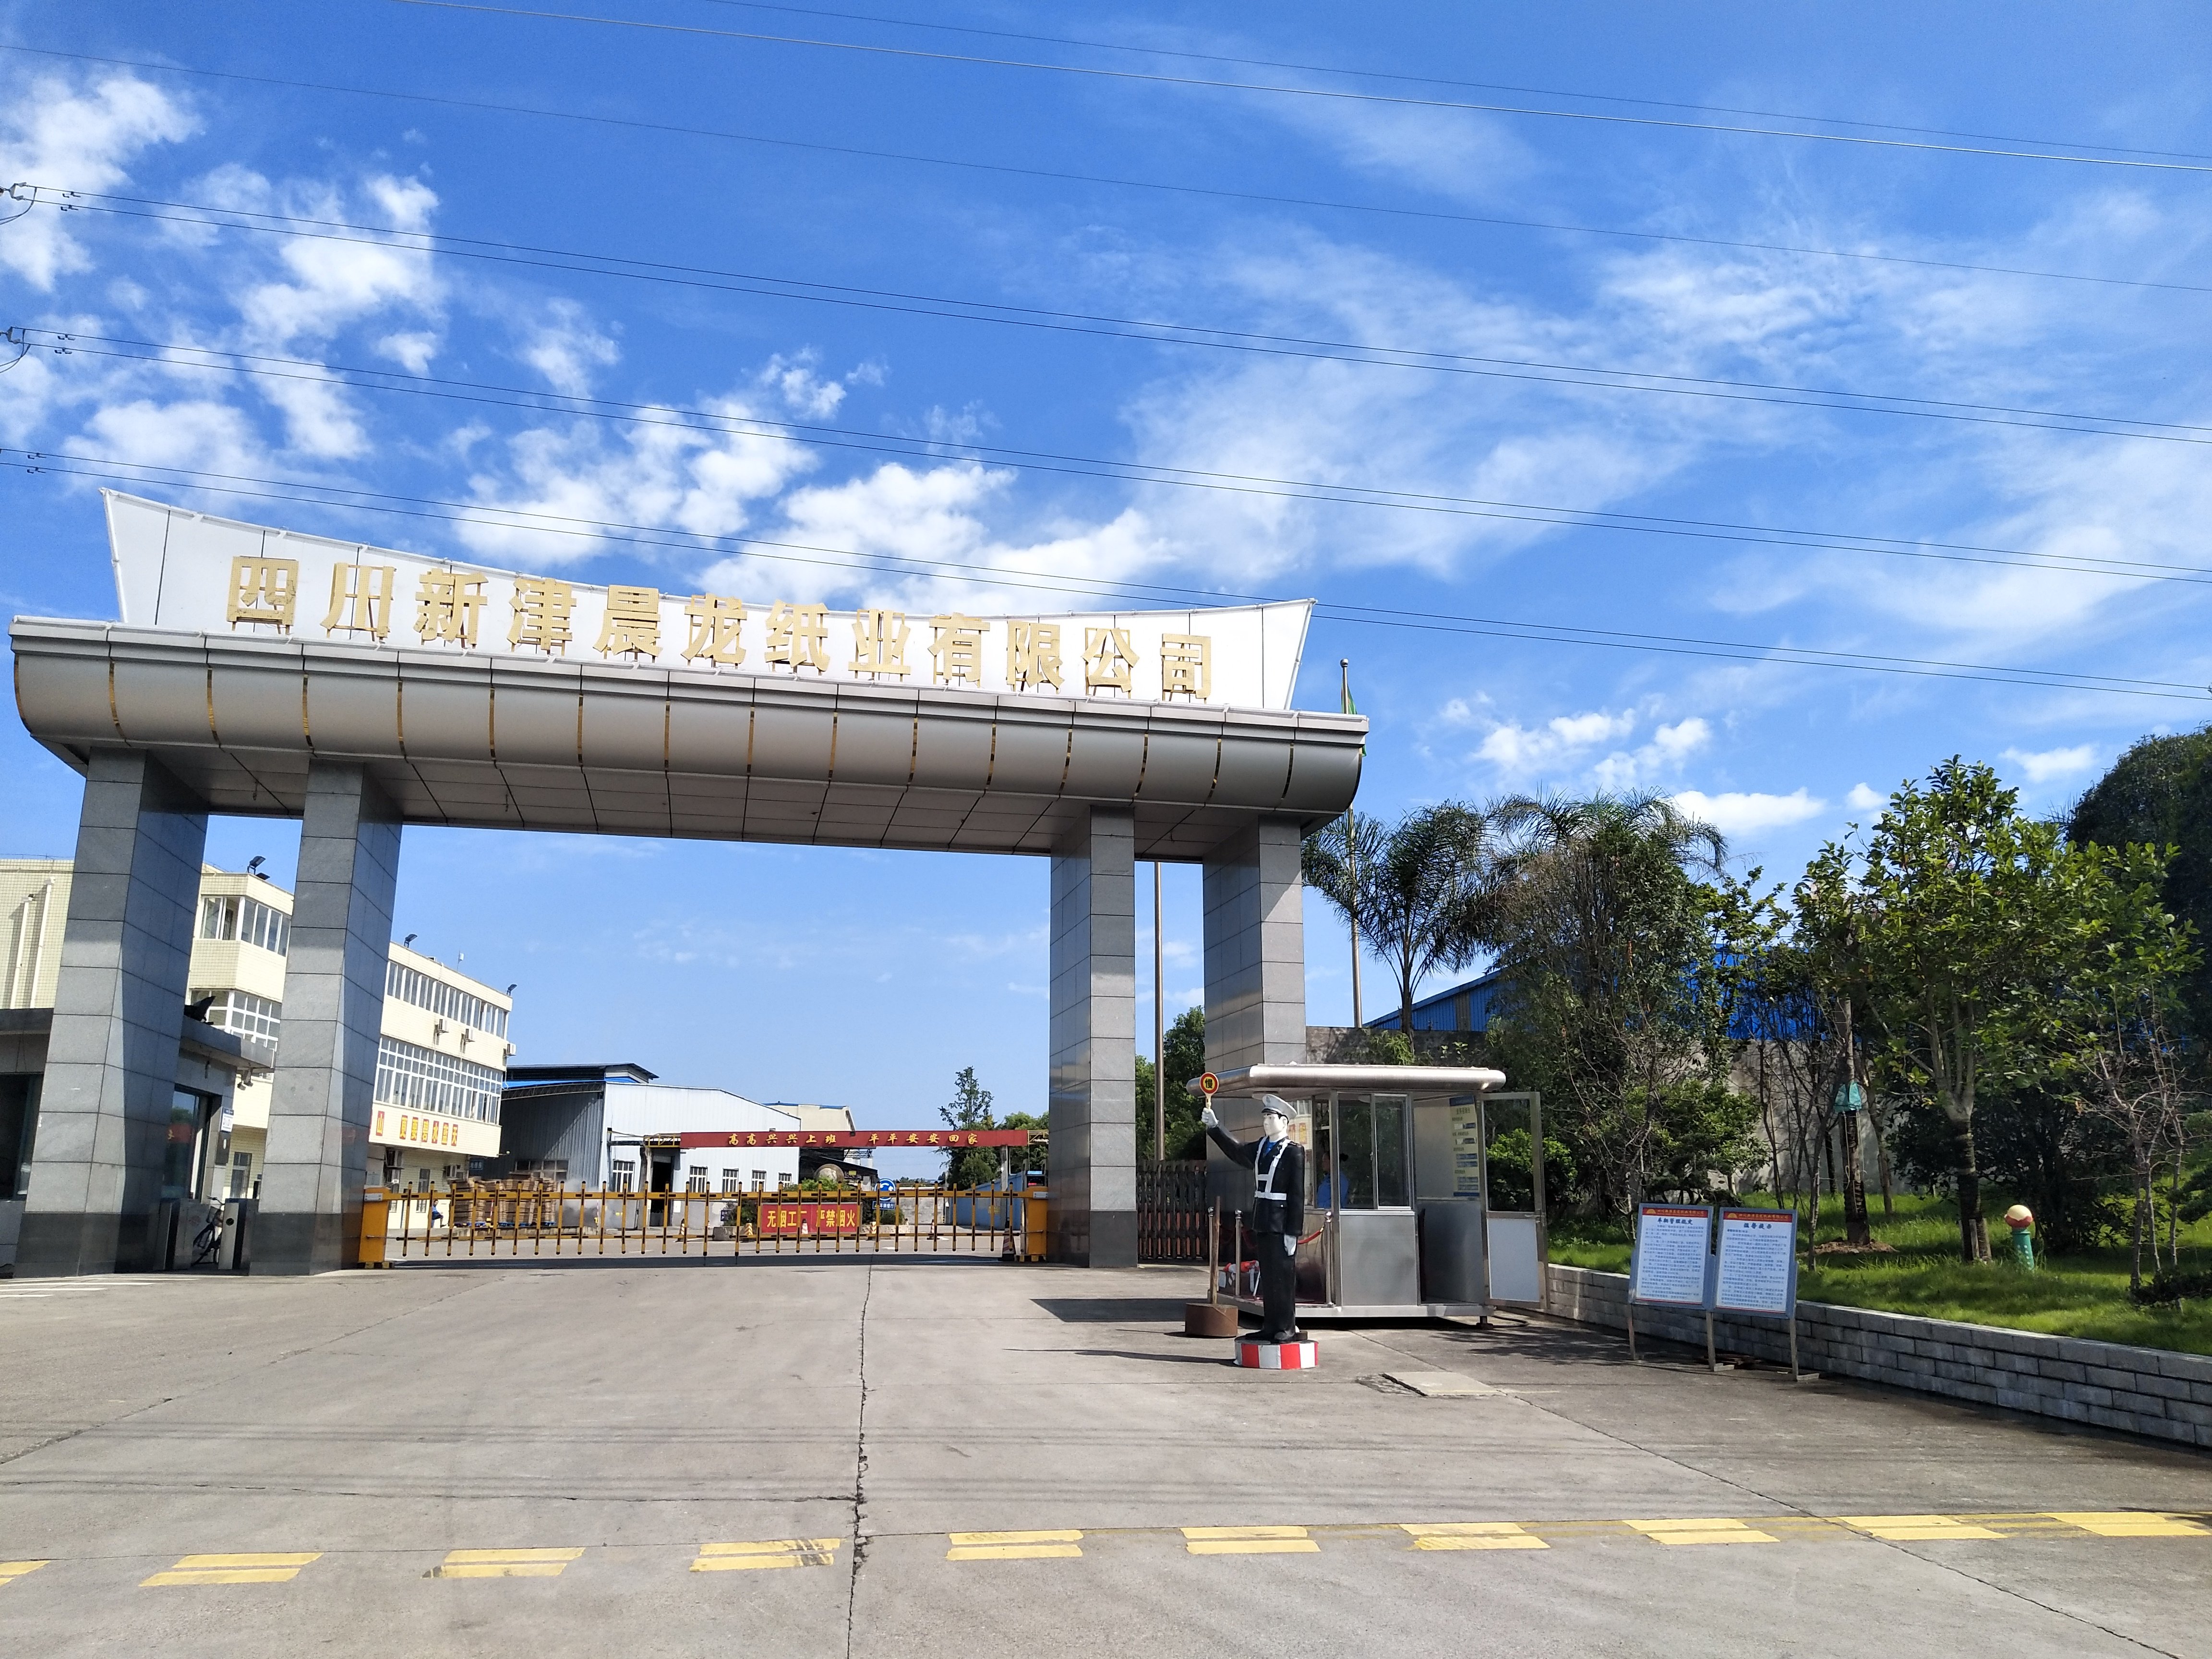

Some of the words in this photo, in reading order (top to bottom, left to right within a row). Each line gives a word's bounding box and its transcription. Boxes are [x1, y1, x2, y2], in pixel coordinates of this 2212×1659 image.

[226, 555, 1213, 698] 四川新津晨龙纸业有限公司
[1205, 1079, 1213, 1088] 慢
[399, 1117, 457, 1144] 更要碧水蓝天
[728, 1133, 837, 1145] 高高兴兴上班
[868, 1132, 978, 1145] 平平安安回家
[816, 1209, 856, 1228] 严禁烟火
